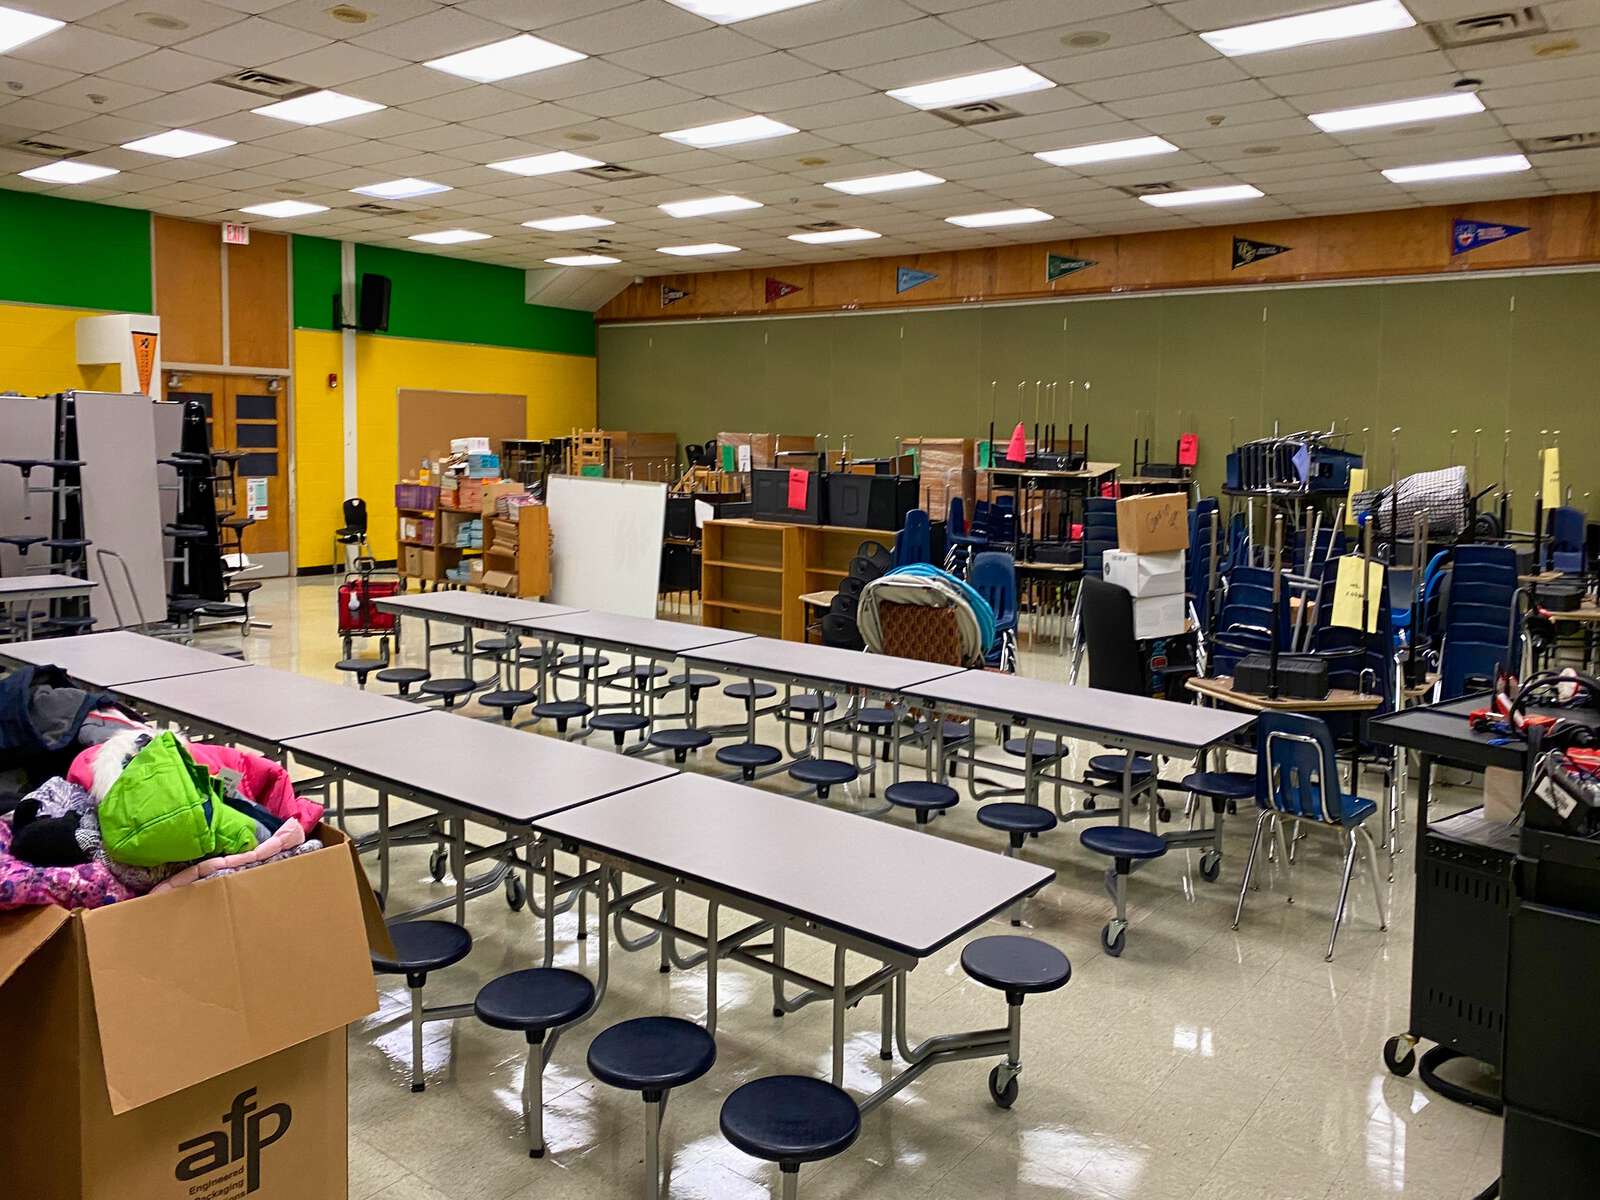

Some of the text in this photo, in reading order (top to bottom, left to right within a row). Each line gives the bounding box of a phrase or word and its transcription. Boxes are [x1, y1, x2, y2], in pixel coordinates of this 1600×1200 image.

[226, 224, 247, 241] EXIT
[175, 1086, 292, 1195] afp
[188, 1165, 245, 1196] Engineered
